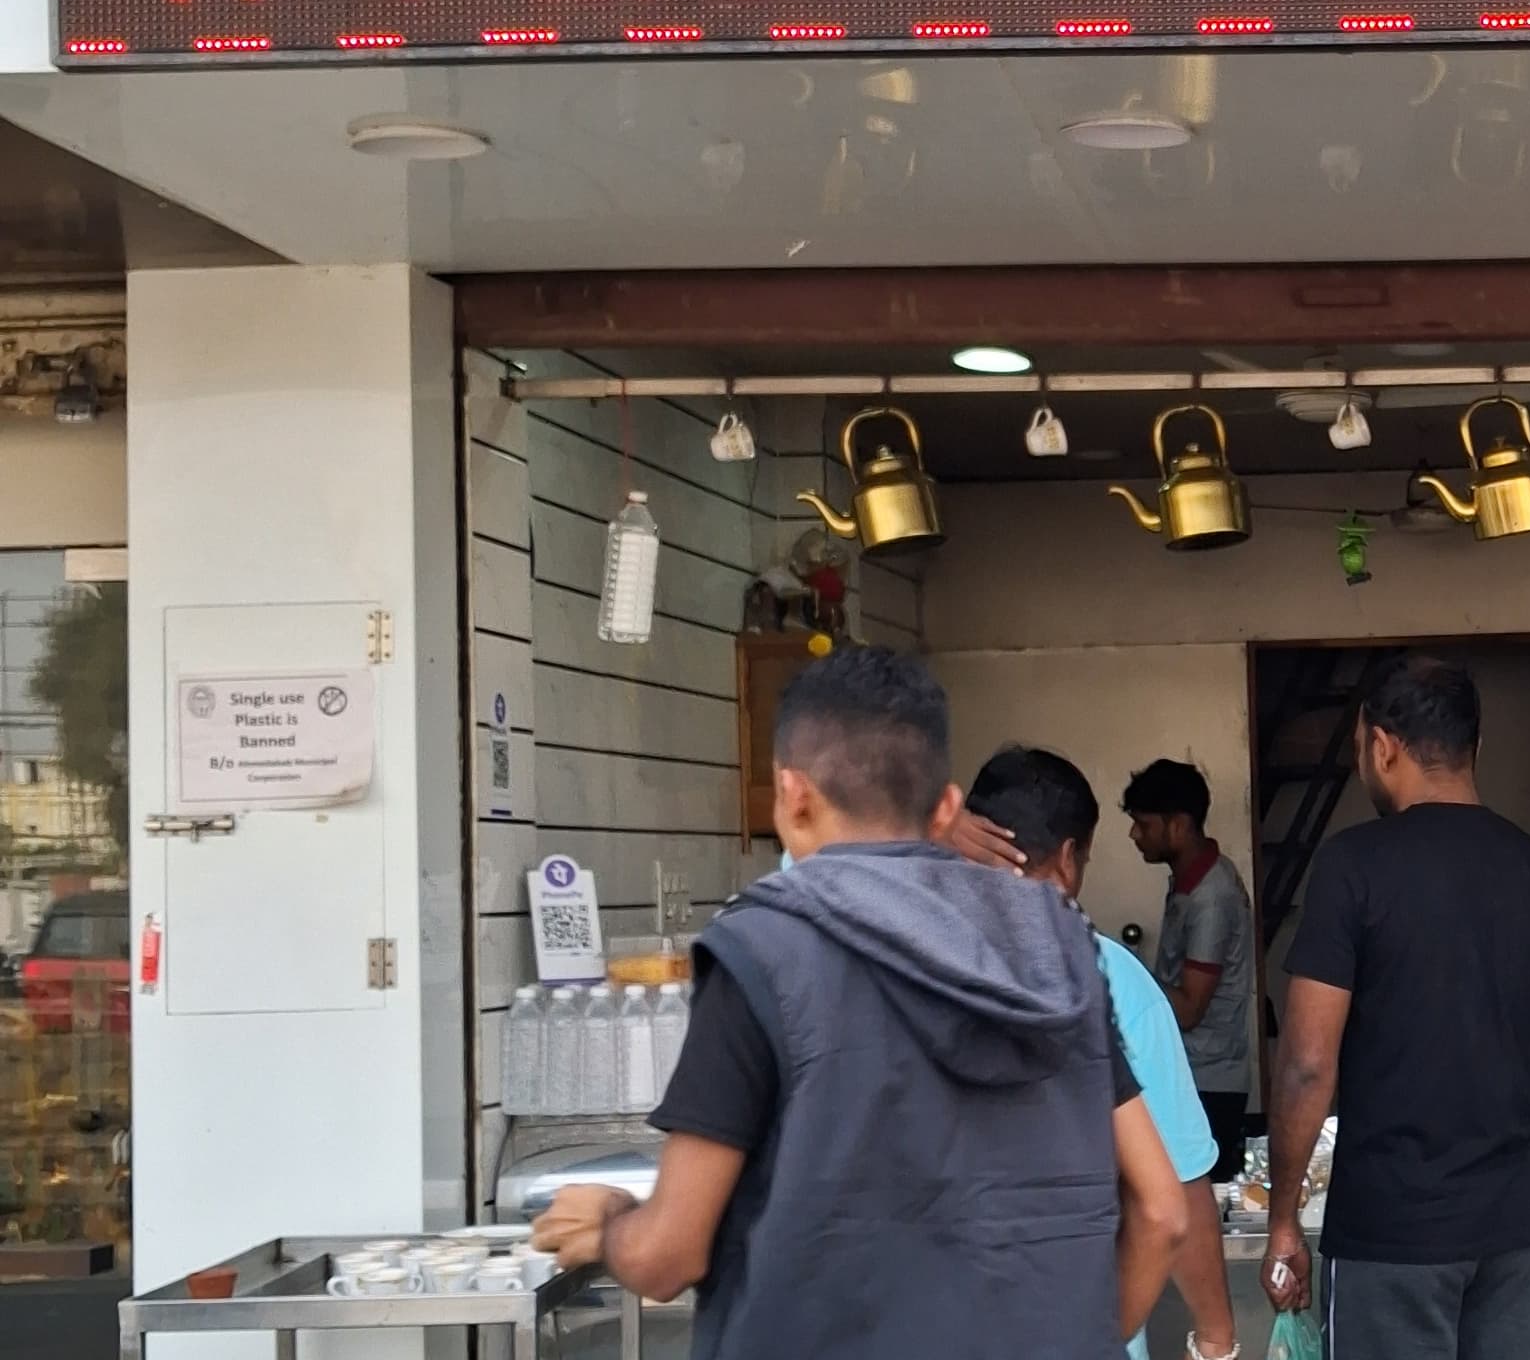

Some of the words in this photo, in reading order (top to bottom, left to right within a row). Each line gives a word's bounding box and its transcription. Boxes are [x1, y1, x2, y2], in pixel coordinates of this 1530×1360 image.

[229, 691, 275, 707] Single
[280, 693, 305, 705] use
[235, 713, 283, 727] Plastic
[287, 713, 298, 726] is
[239, 735, 297, 748] Banned
